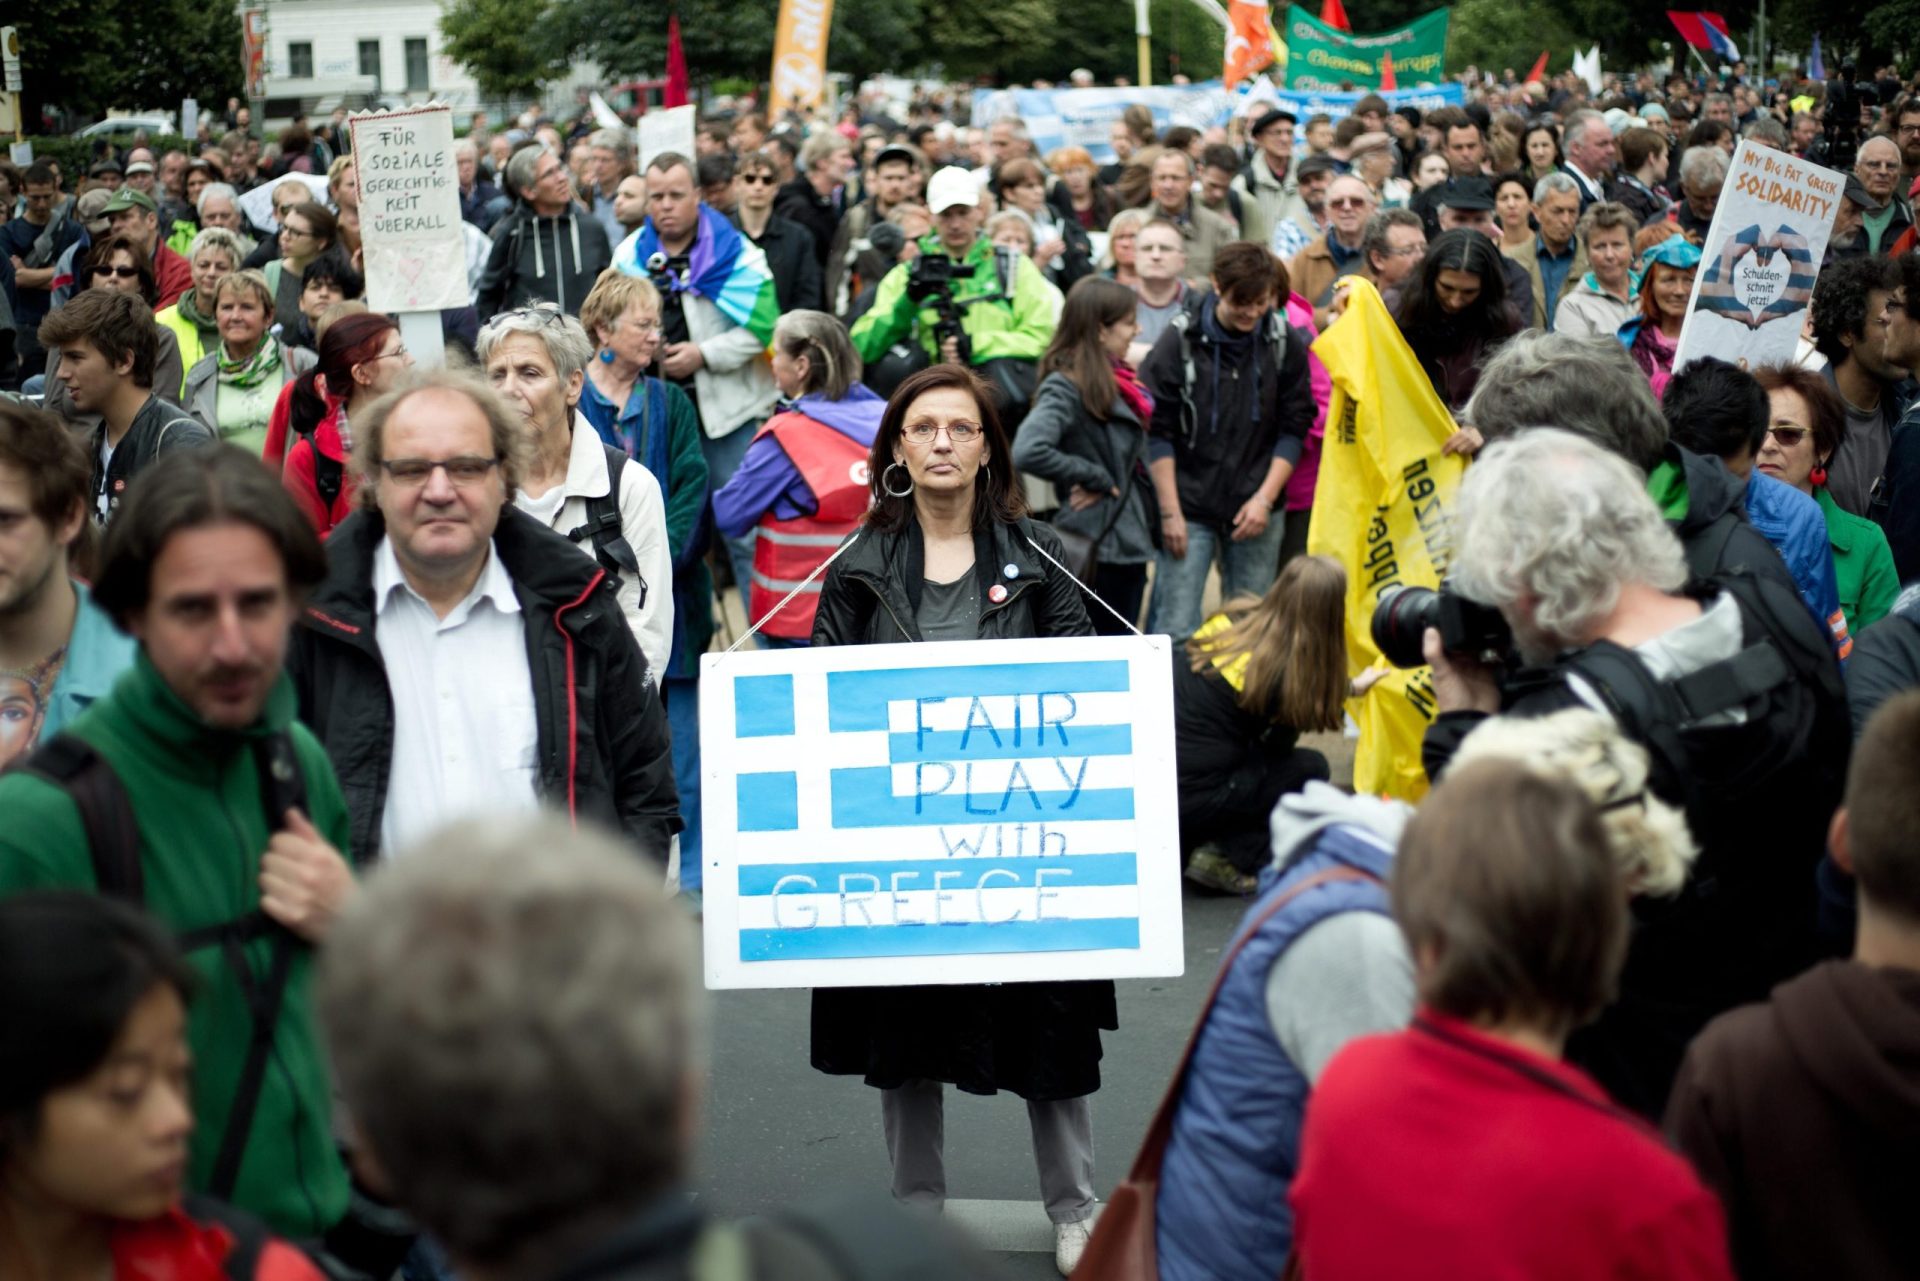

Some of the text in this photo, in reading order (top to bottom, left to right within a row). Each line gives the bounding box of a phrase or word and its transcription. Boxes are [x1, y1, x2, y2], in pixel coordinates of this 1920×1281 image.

[379, 126, 416, 147] FÜR
[1735, 171, 1833, 220] SOLIDARITY
[374, 215, 447, 233] ÜBERALL
[1742, 267, 1784, 281] Schulden-
[1746, 282, 1775, 294] schnitt
[1746, 294, 1771, 307] jetzt!
[915, 691, 1077, 752] FAIR
[914, 756, 1088, 816] PLAY
[771, 868, 1074, 931] GREECE
